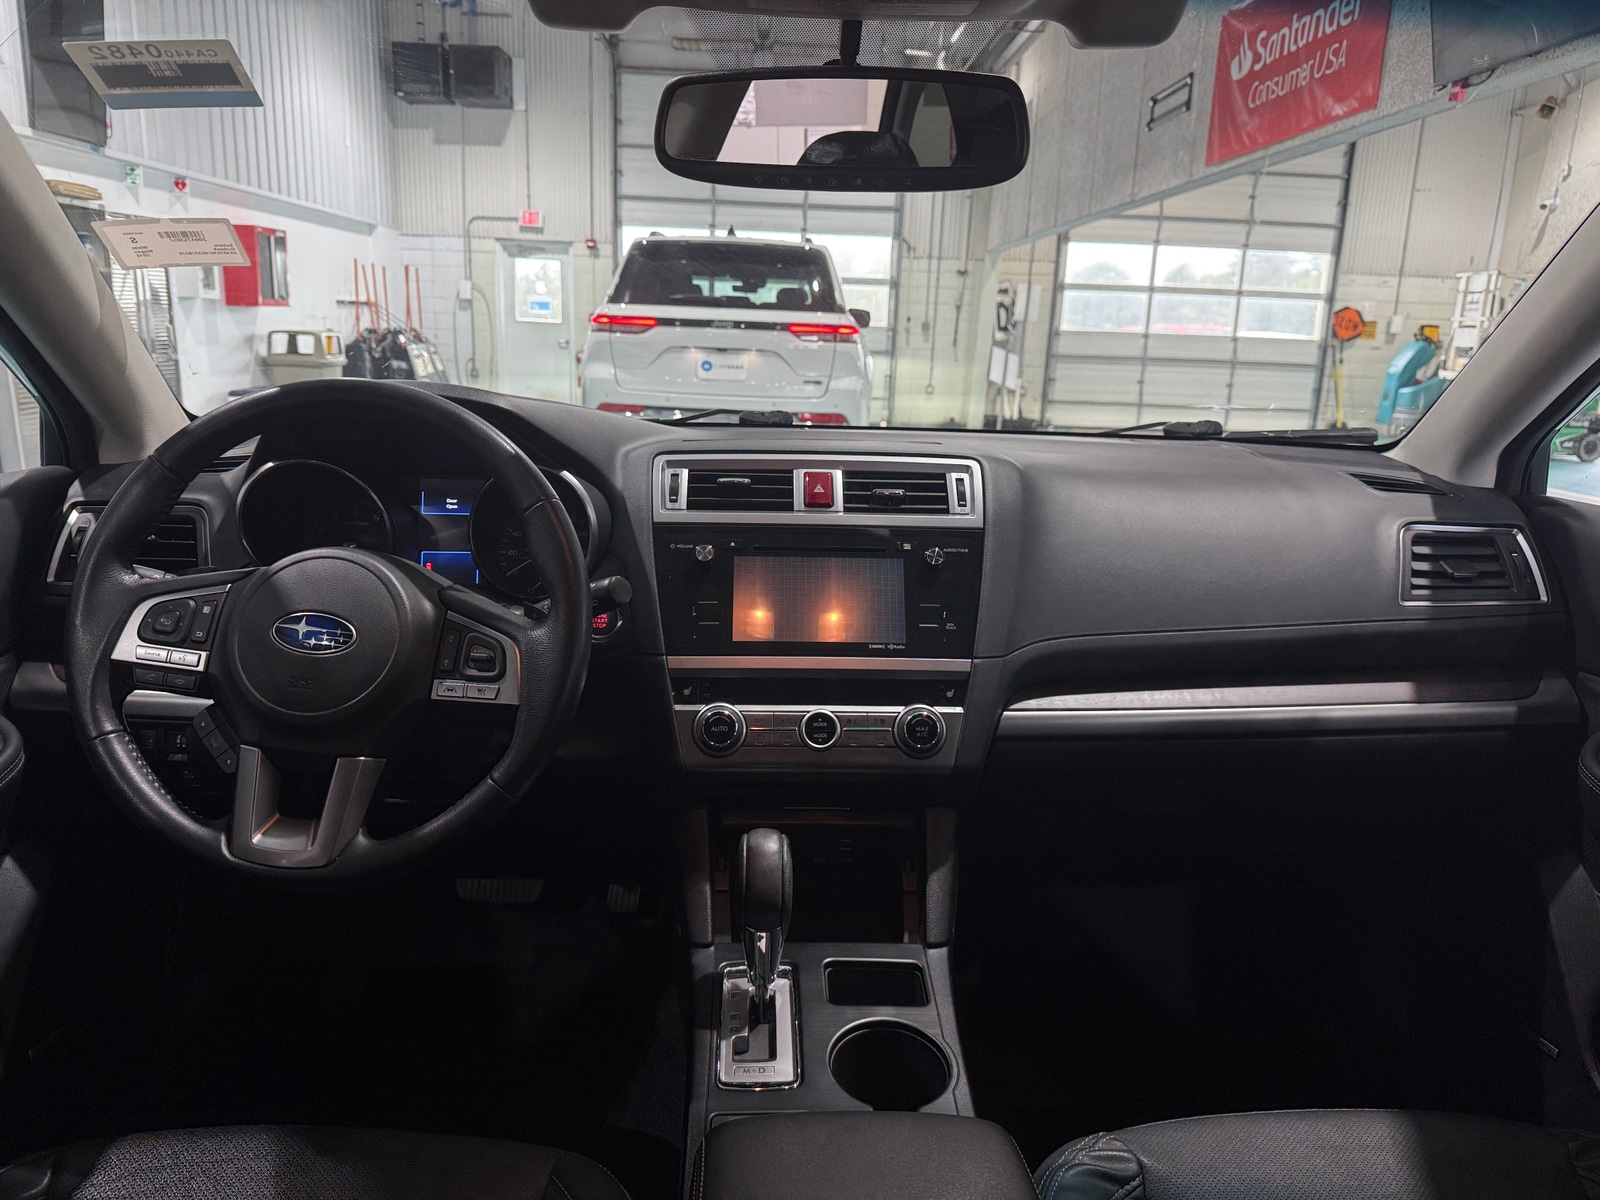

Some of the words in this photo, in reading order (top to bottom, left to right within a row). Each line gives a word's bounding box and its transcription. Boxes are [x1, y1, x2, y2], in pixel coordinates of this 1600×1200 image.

[1253, 0, 1361, 71] Santander
[1248, 59, 1314, 108] Consumer
[1313, 39, 1348, 79] USA
